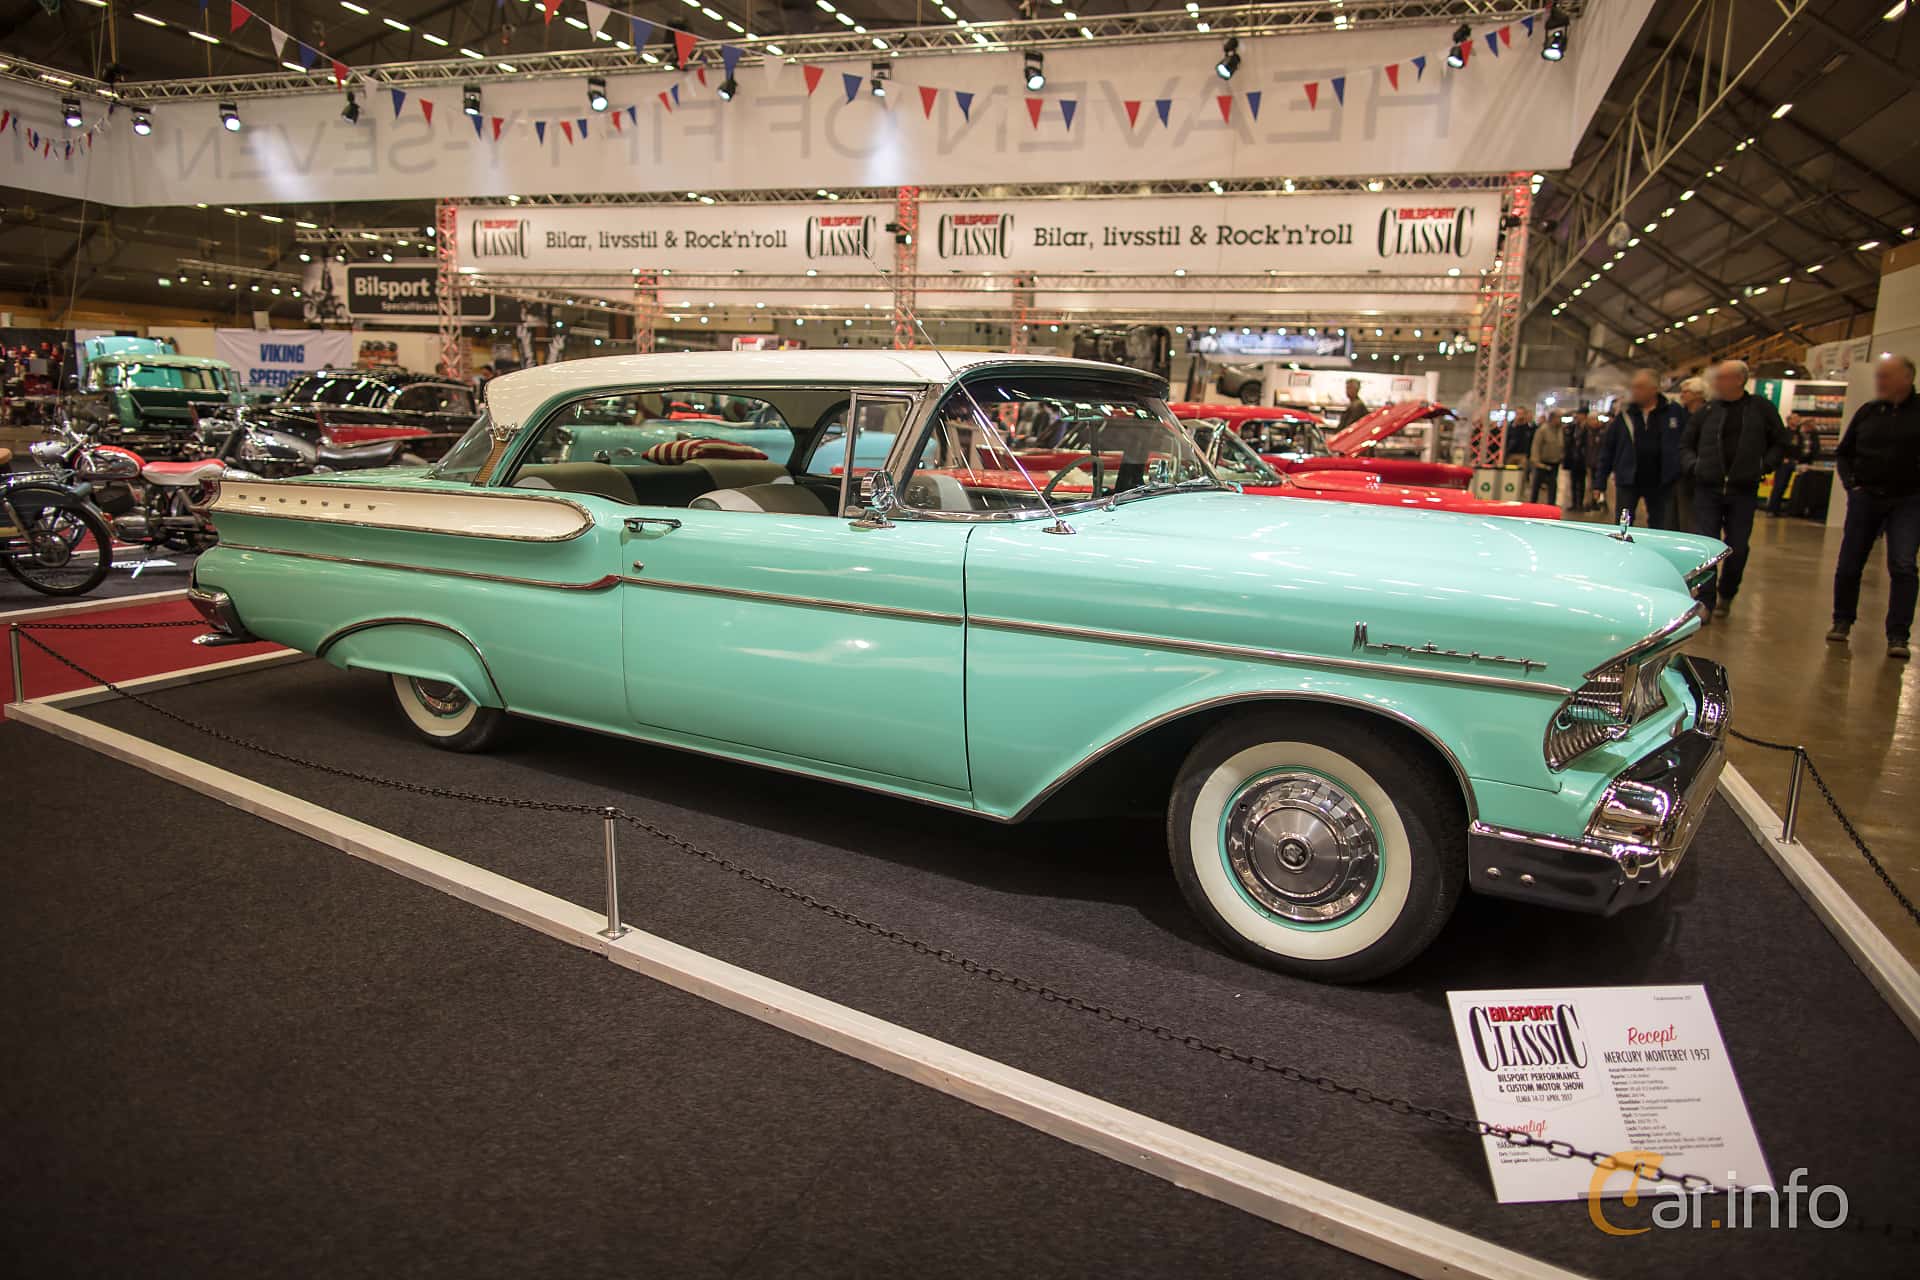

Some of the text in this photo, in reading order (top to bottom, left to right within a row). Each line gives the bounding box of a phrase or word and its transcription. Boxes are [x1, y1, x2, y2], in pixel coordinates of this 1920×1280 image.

[473, 219, 529, 258] CLASSIC
[546, 230, 787, 250] Bilar, livsstil & Rock'n'roll
[806, 216, 876, 259] CLASSIC
[938, 213, 1014, 259] CLASSIC
[1034, 224, 1352, 250] Bilar, livsstil & Rock'n'roll
[1378, 206, 1475, 257] CLASSIC
[355, 276, 430, 300] Bilsport
[260, 343, 304, 363] VIKING
[1488, 1005, 1554, 1022] BILSPORT
[1469, 1004, 1587, 1072] CLASSIC
[1627, 1023, 1677, 1048] Recept
[1604, 1048, 1710, 1063] MERCURY MONTEREY 1957
[1497, 1071, 1580, 1082] BILSPORT PERFORMANCE
[1506, 1083, 1534, 1093] CUSTOM
[1536, 1082, 1561, 1091] MOTOR
[1563, 1081, 1584, 1091] SHOW
